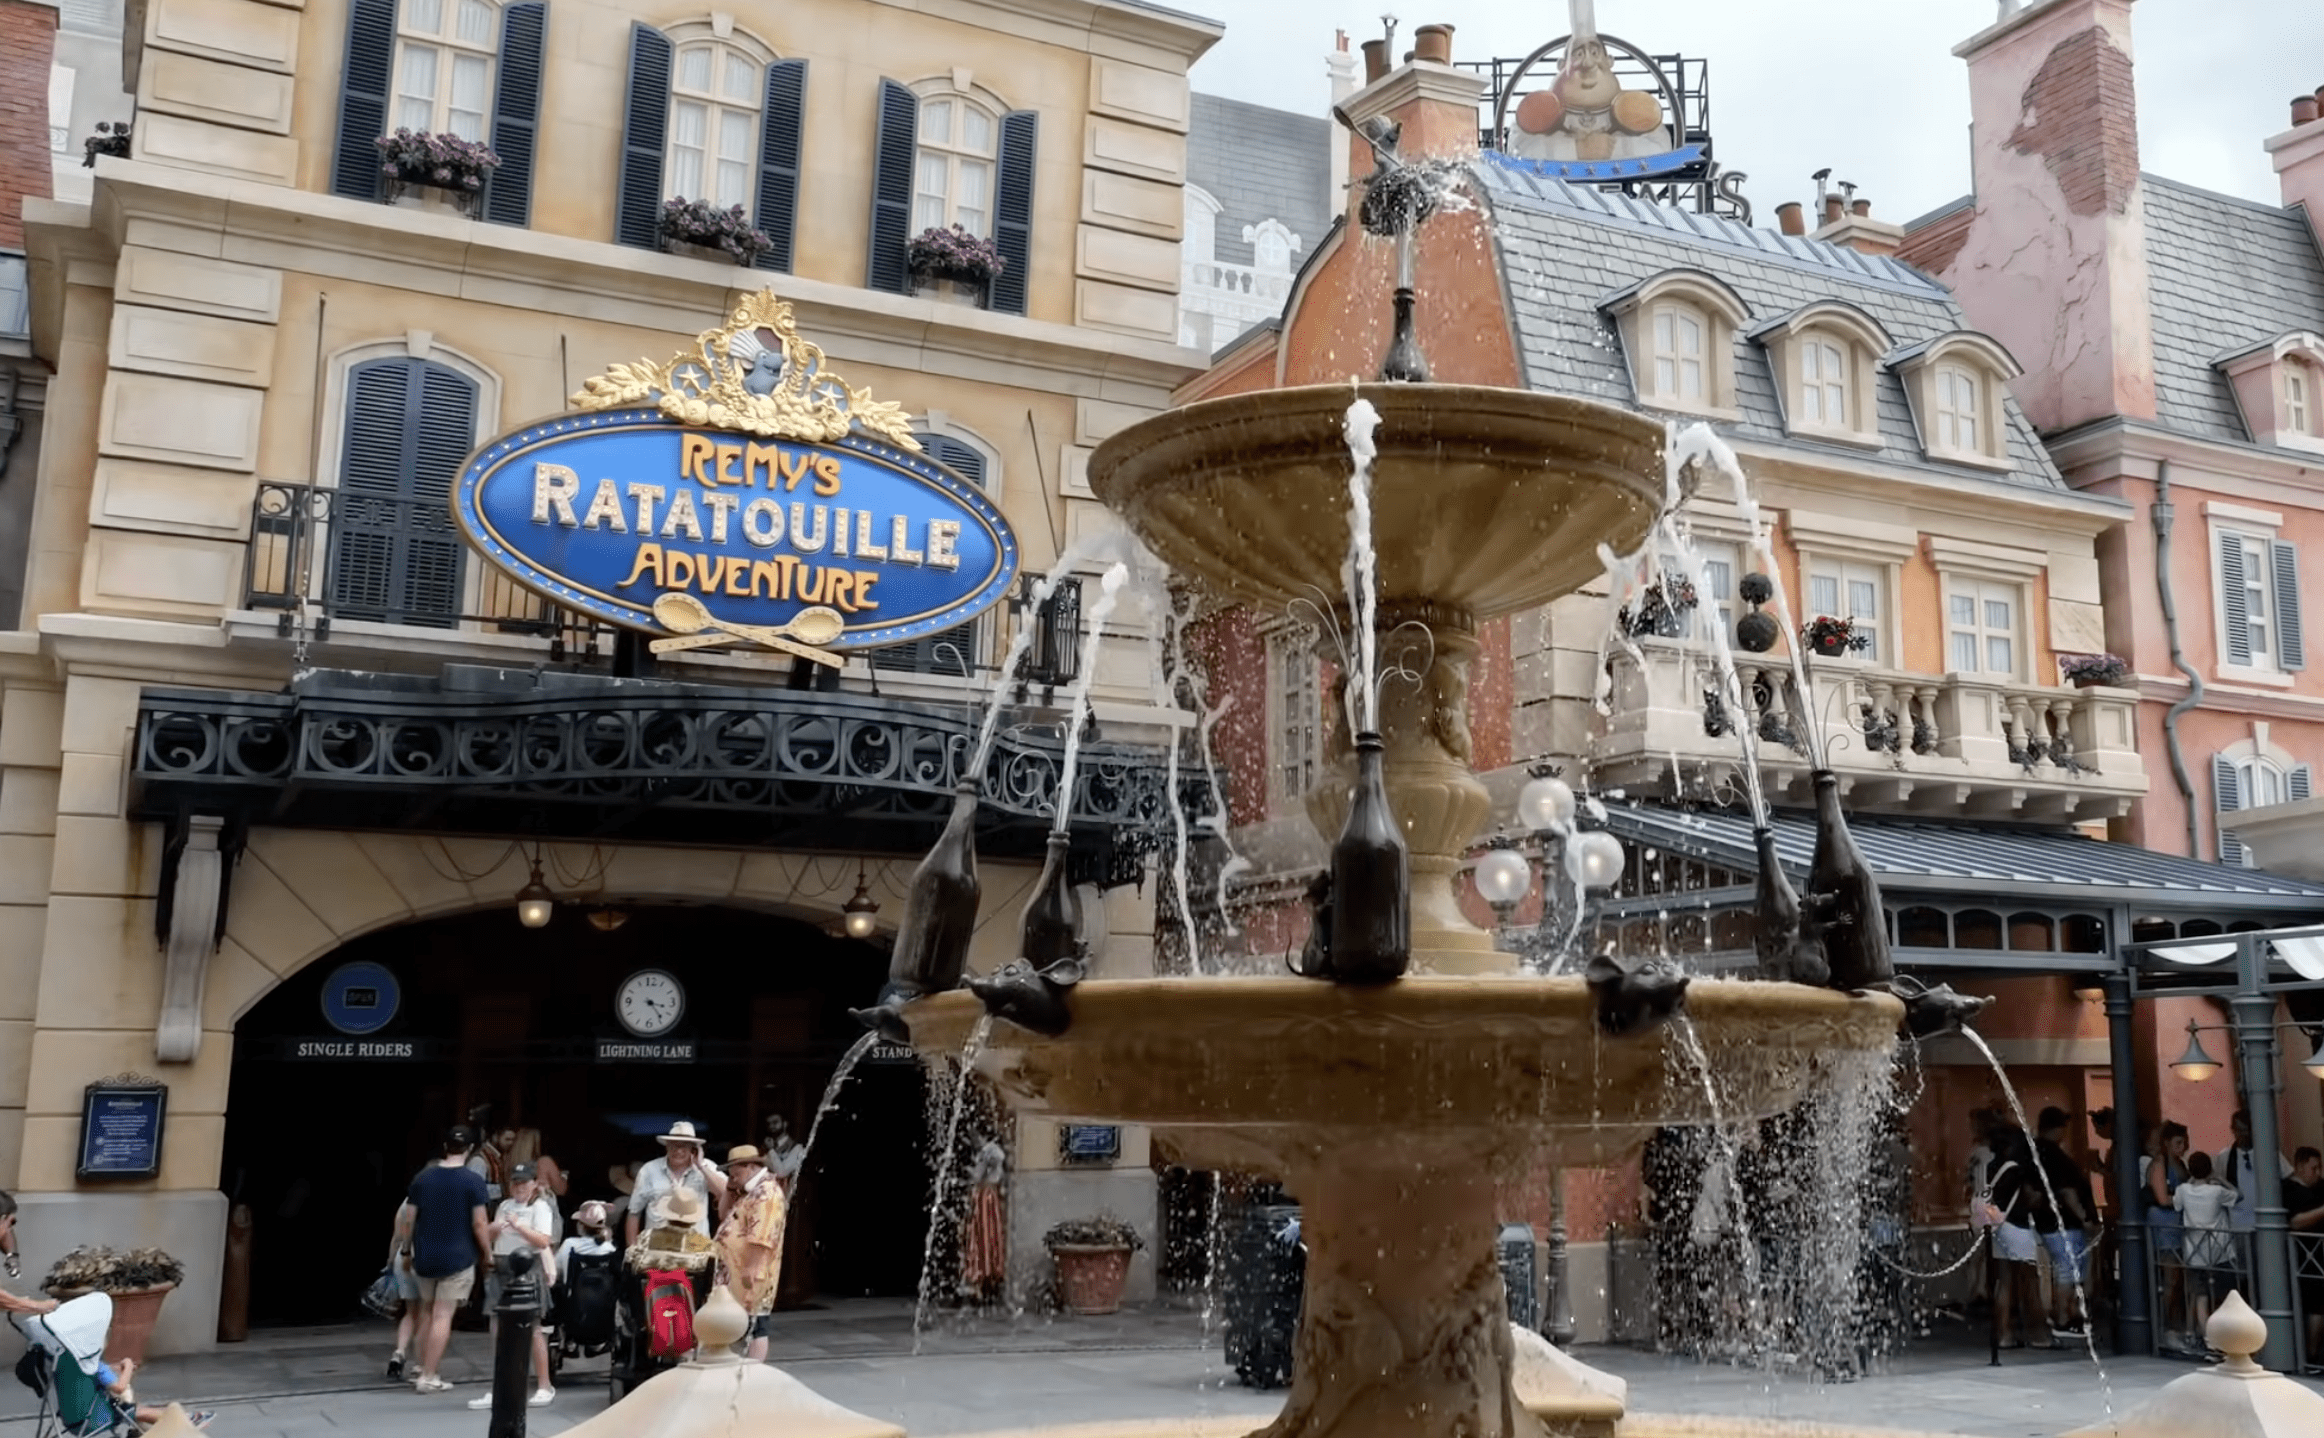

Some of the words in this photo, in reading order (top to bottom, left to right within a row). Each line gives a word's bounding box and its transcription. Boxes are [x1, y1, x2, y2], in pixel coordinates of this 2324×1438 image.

[681, 433, 842, 496] REMY'S
[532, 462, 961, 572] RATATOUILLE
[617, 542, 880, 613] ADVENTURE
[646, 977, 657, 987] 12
[625, 997, 632, 1007] 9
[669, 997, 676, 1008] 3
[645, 1018, 653, 1028] 6
[297, 1042, 354, 1057] SINGLE
[358, 1043, 413, 1058] RIDERS
[600, 1045, 661, 1058] LIGHTNING
[663, 1045, 692, 1058] LANE
